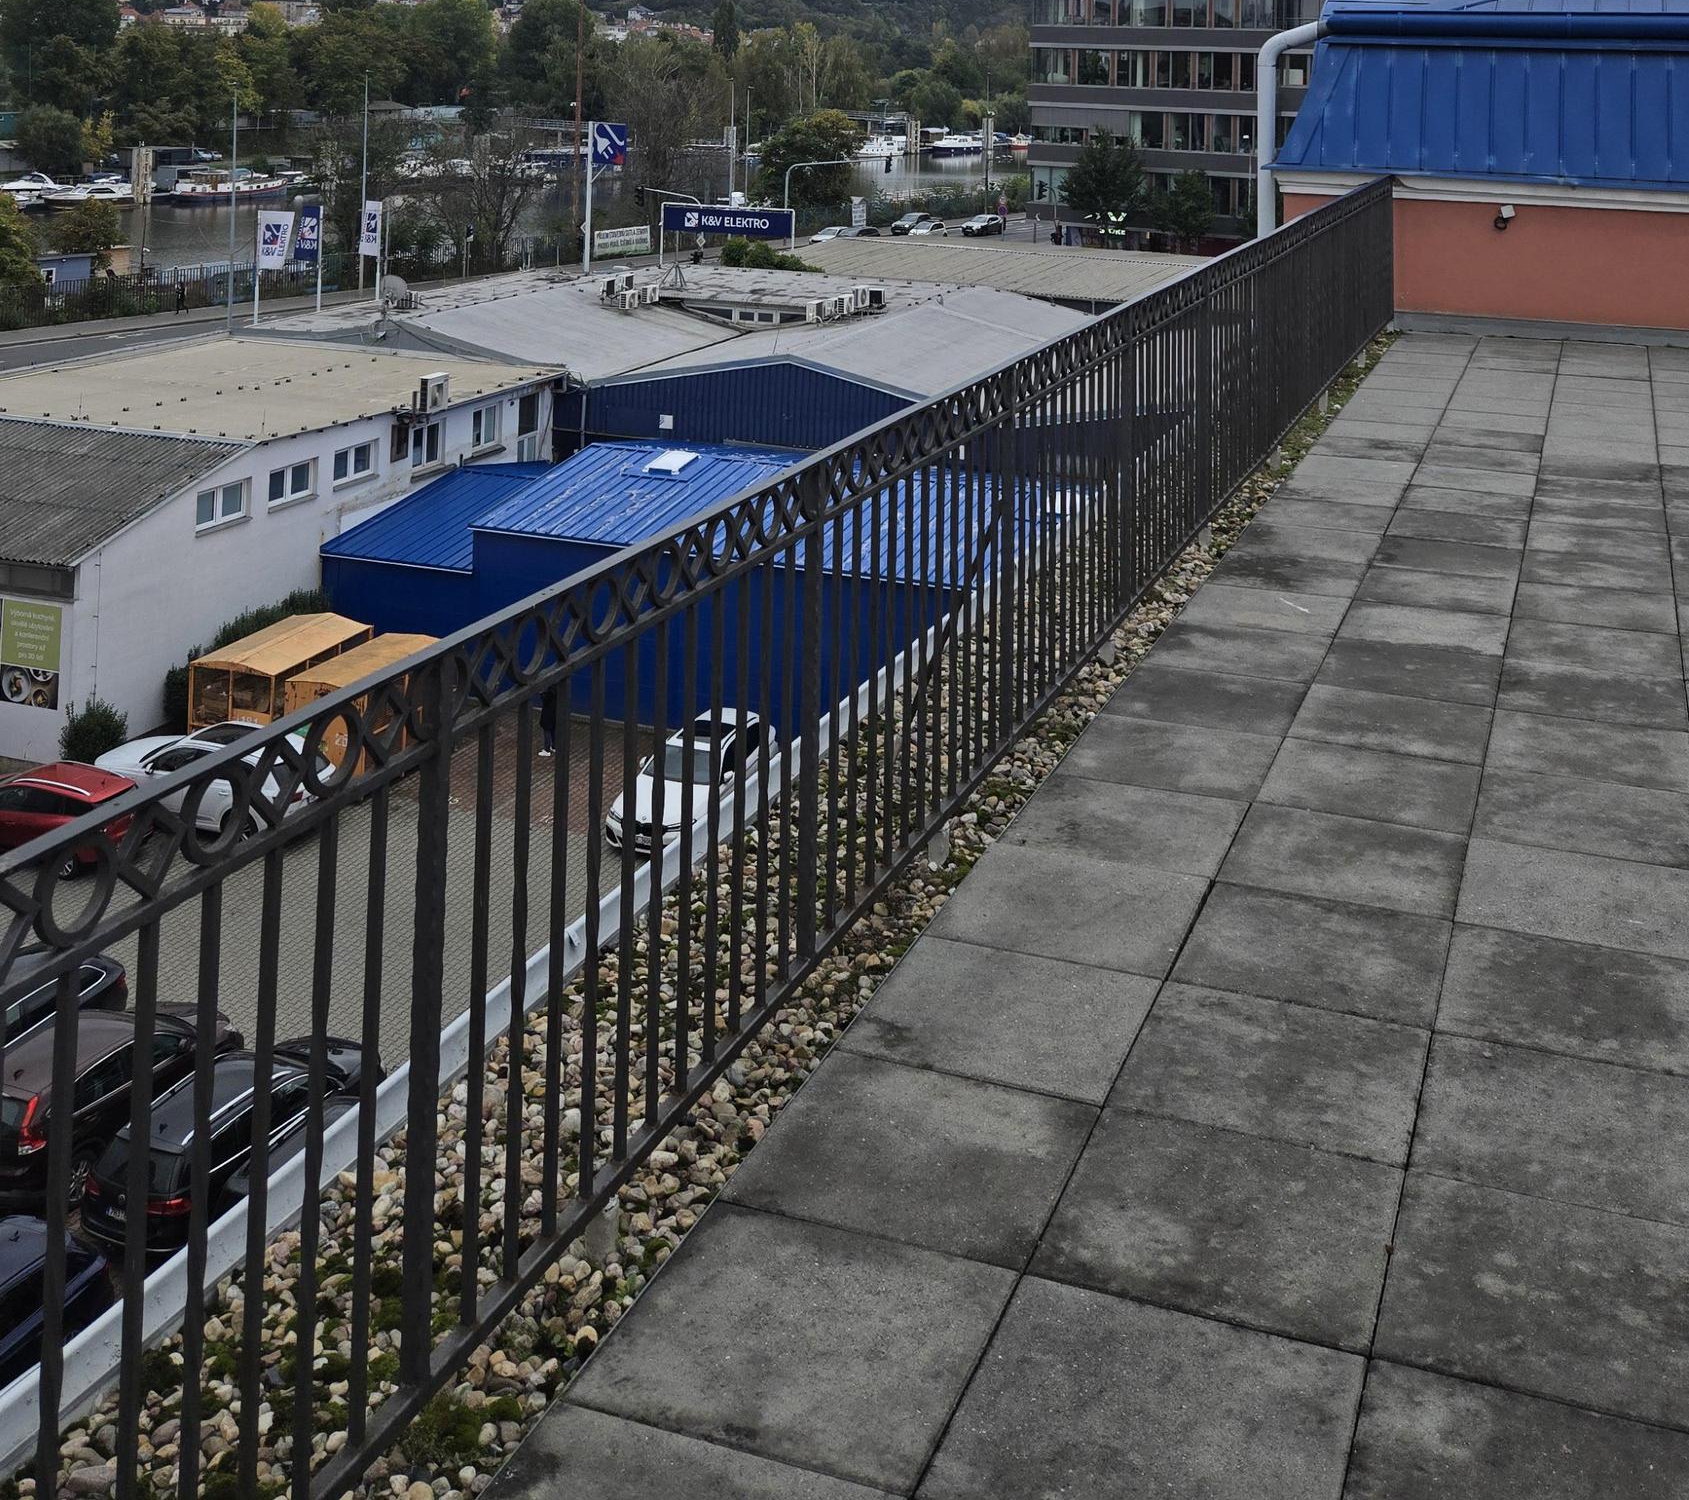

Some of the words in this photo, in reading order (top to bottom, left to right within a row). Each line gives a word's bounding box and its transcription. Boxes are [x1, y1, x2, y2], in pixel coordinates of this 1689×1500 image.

[701, 215, 722, 226] K&V
[724, 216, 769, 229] ELEKTRO
[277, 223, 289, 256] ELEKTRO
